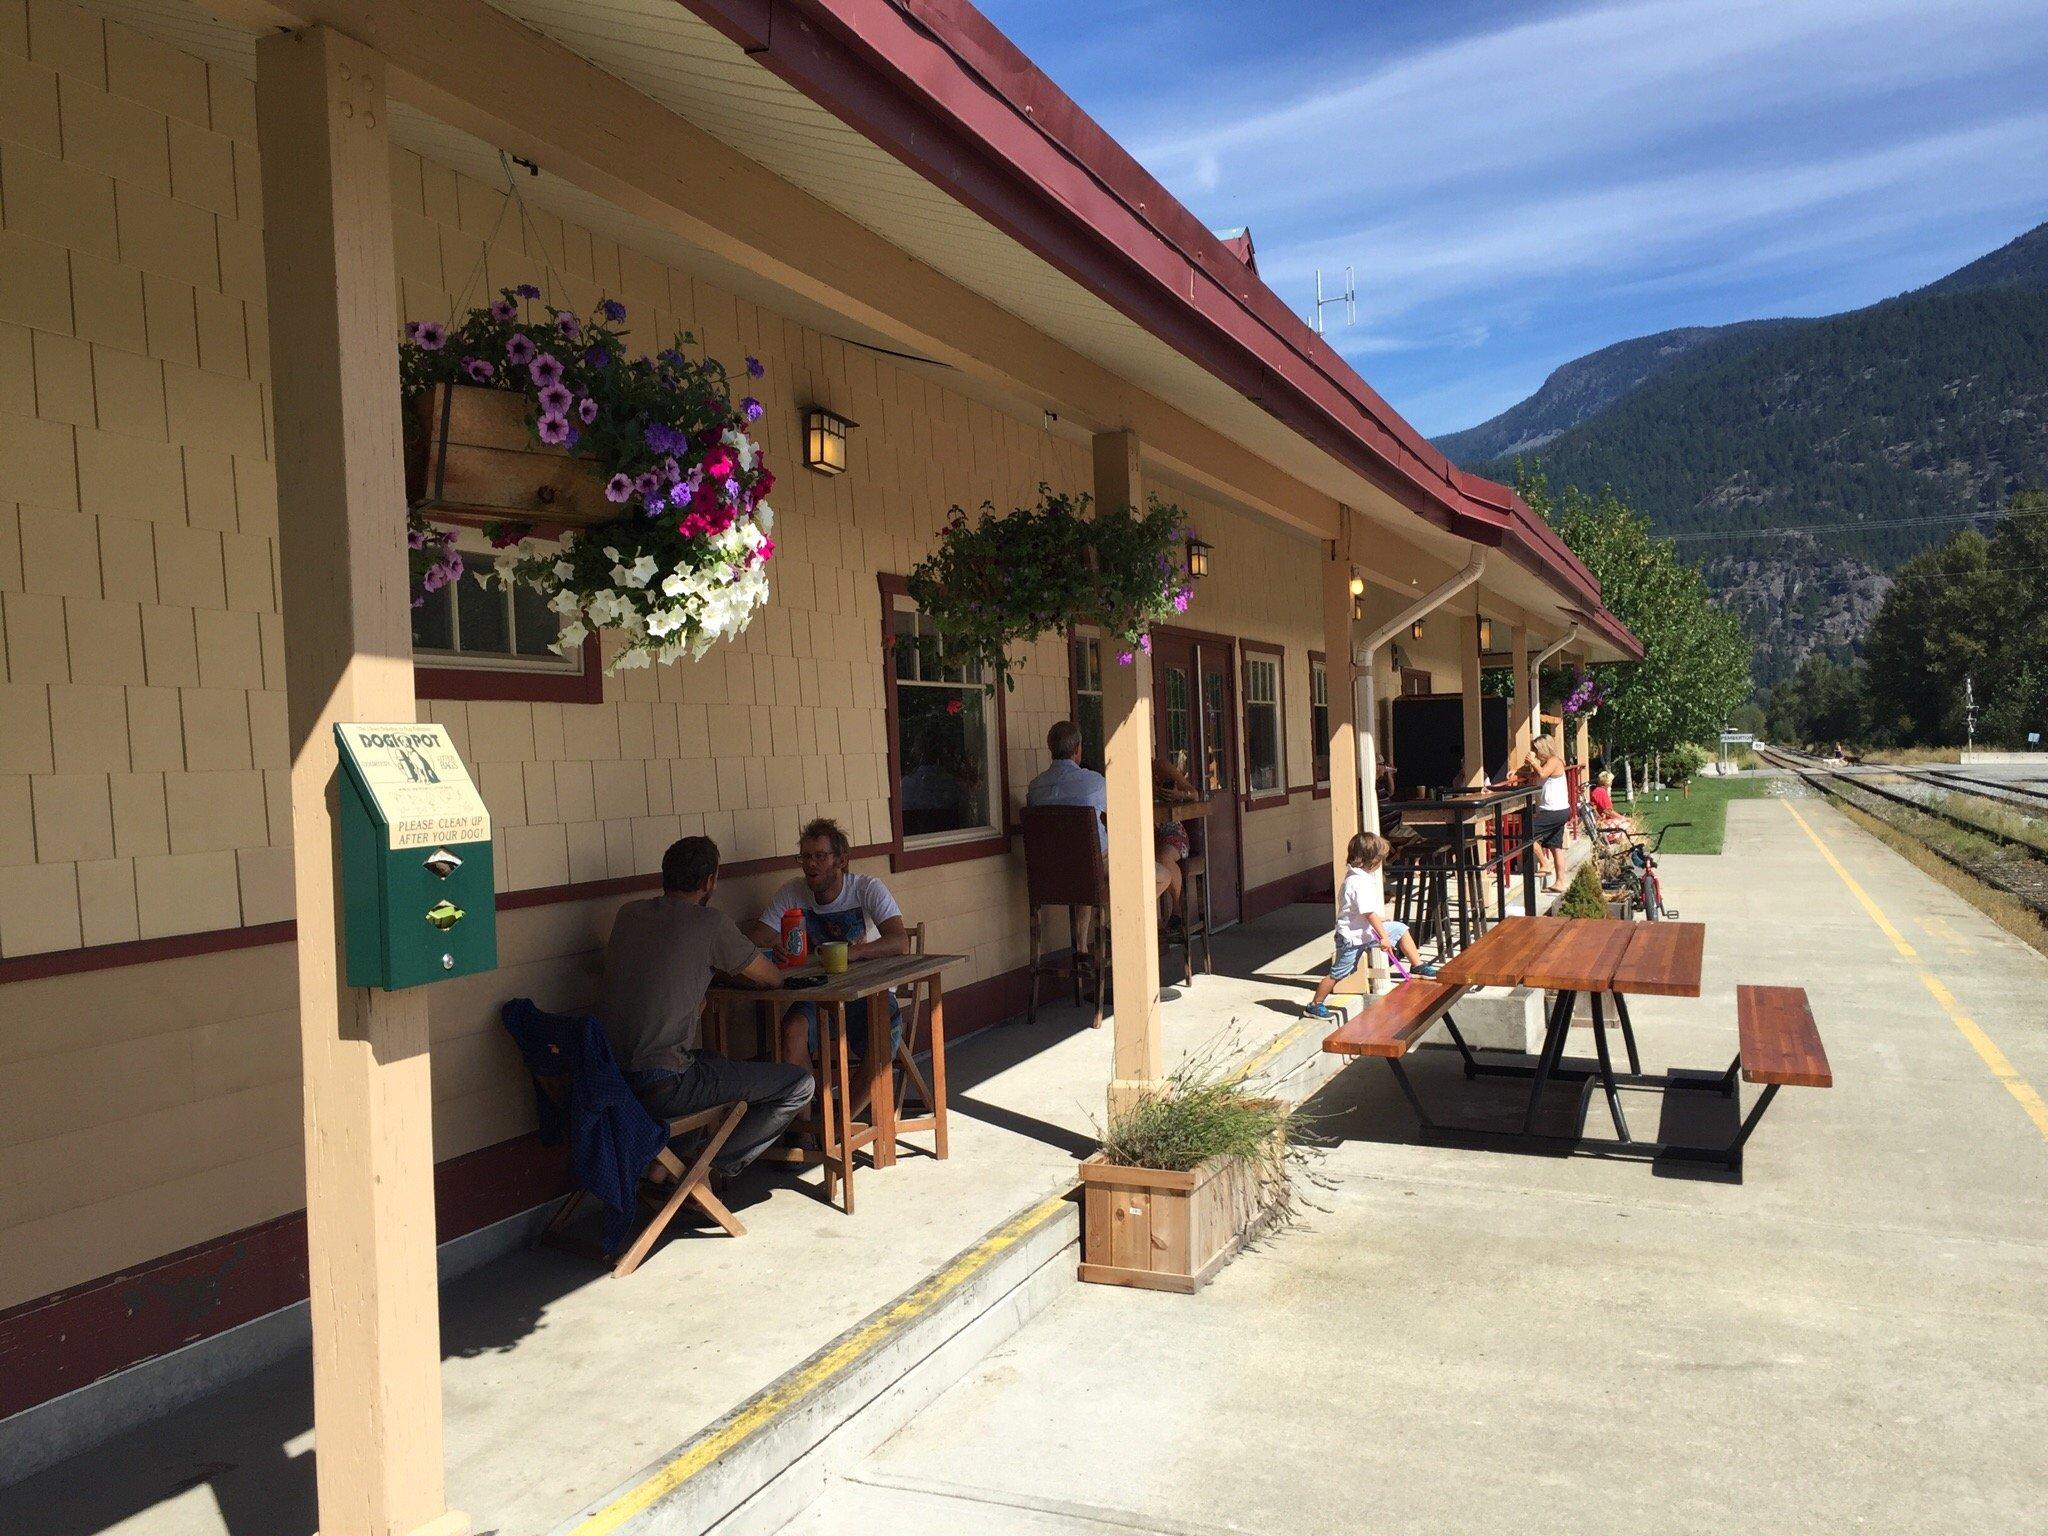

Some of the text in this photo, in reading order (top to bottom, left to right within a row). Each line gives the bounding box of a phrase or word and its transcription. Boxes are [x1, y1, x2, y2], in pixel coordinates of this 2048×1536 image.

[398, 816, 483, 832] PLEASE CLEAN UP
[398, 829, 484, 845] AFTER YOUR DOG!
